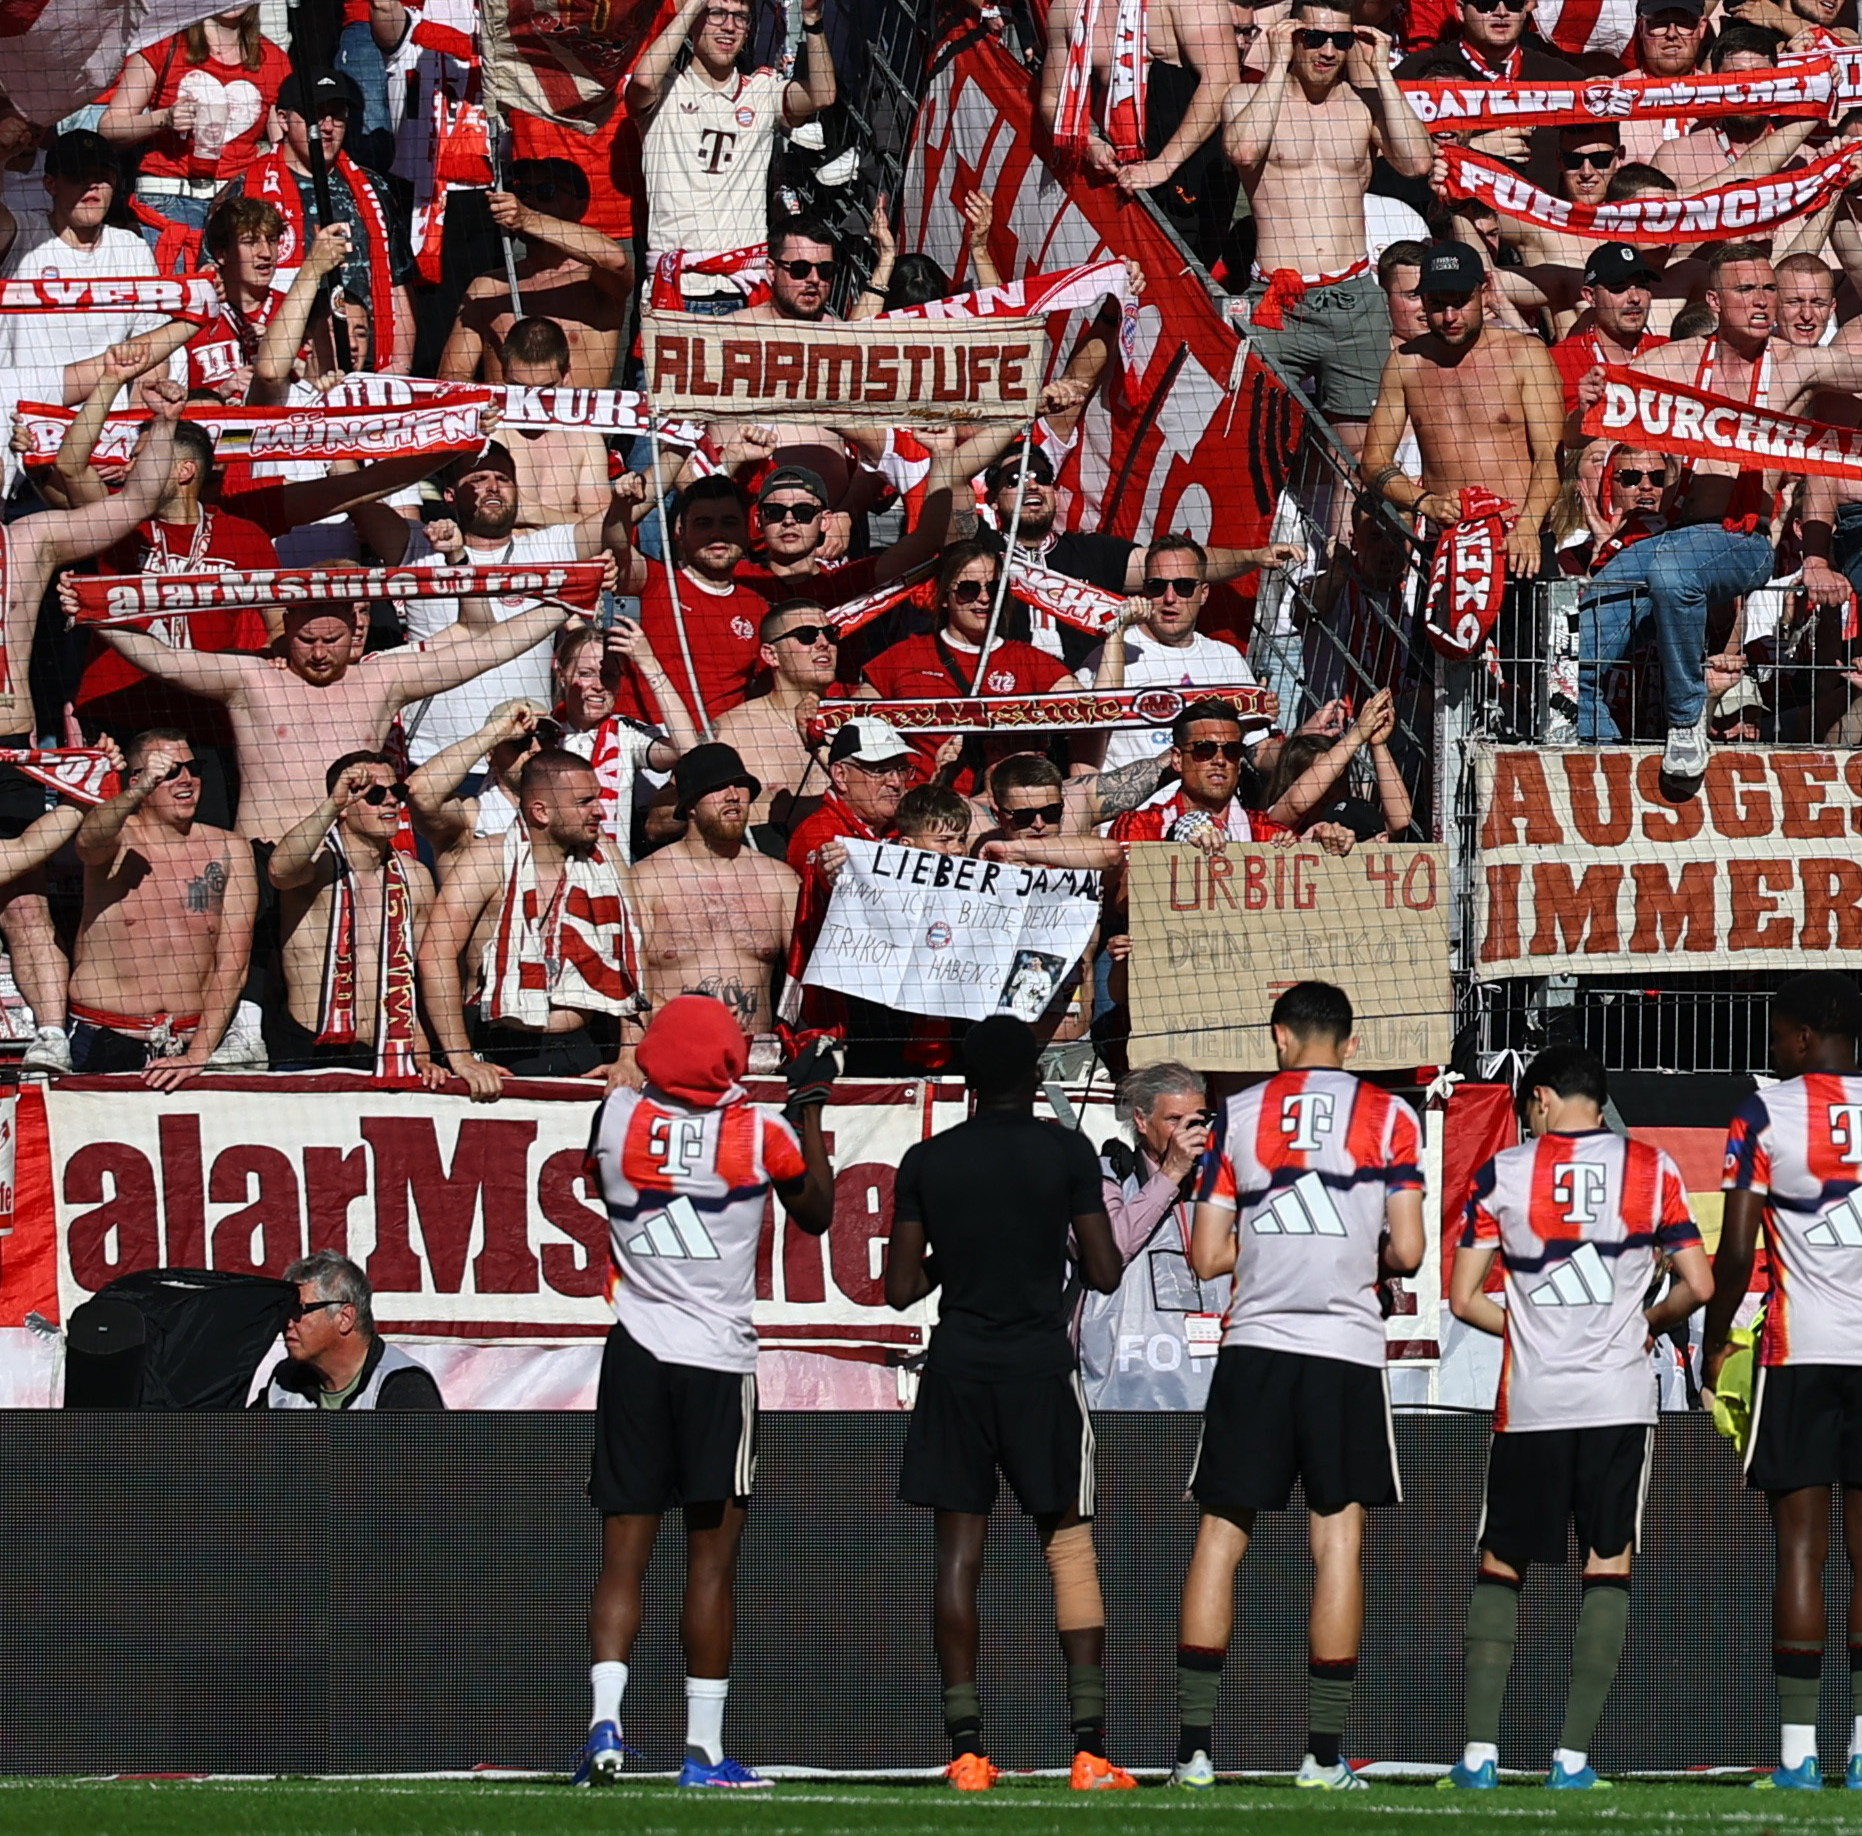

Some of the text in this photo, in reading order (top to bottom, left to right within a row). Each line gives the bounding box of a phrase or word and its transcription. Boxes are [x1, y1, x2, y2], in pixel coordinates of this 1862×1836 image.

[1412, 84, 1576, 123] BAYERN
[249, 407, 483, 457] MÜNCHEN
[107, 566, 568, 619] alarMstufe rot
[870, 842, 1002, 895] LIEBER
[1168, 853, 1438, 913] URBIG 40
[1167, 929, 1427, 971] DEIN TRIKOT
[62, 1111, 898, 1307] alarMse
